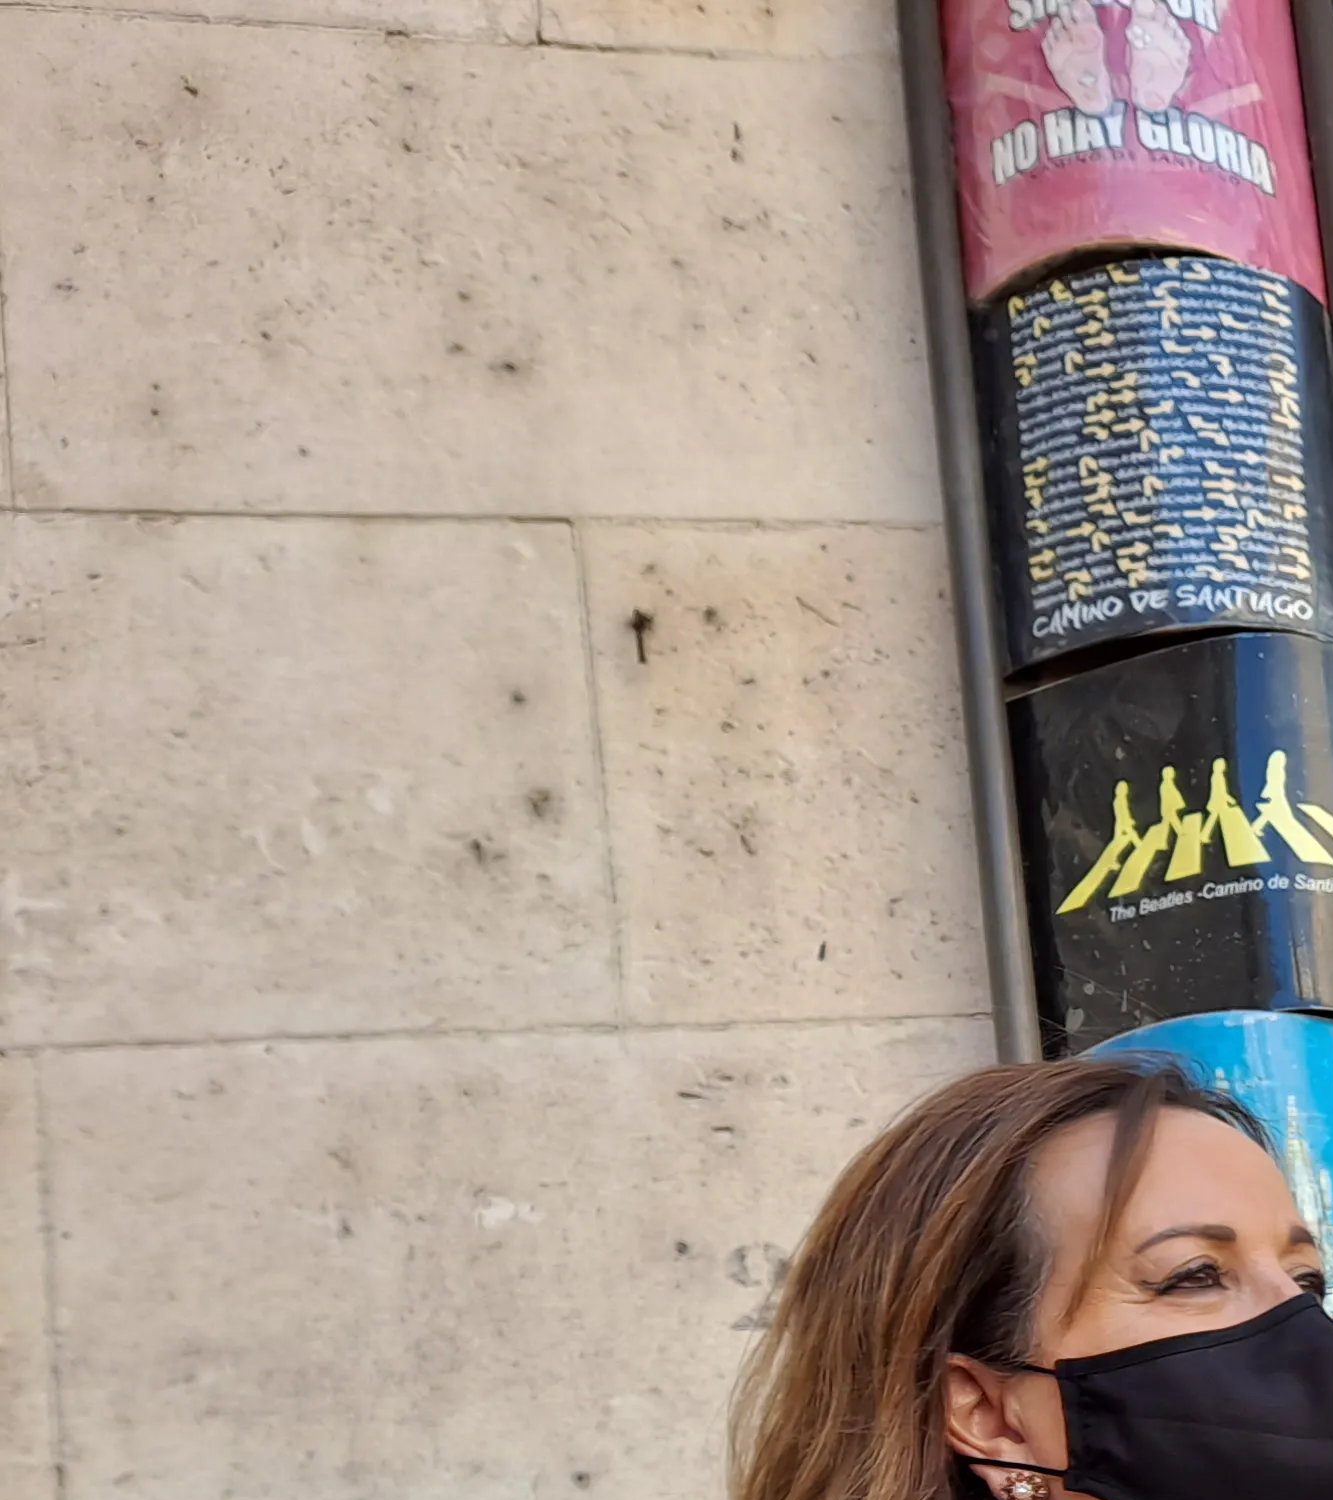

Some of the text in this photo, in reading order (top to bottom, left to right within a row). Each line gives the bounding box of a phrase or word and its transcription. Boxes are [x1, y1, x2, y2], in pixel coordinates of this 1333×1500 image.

[991, 100, 1276, 197] NO HAY GLORIA
[1033, 584, 1313, 638] CAMINO DE SANTIAGO
[1109, 905, 1135, 923] The
[1139, 891, 1193, 915] Beatles
[1267, 874, 1289, 889] de
